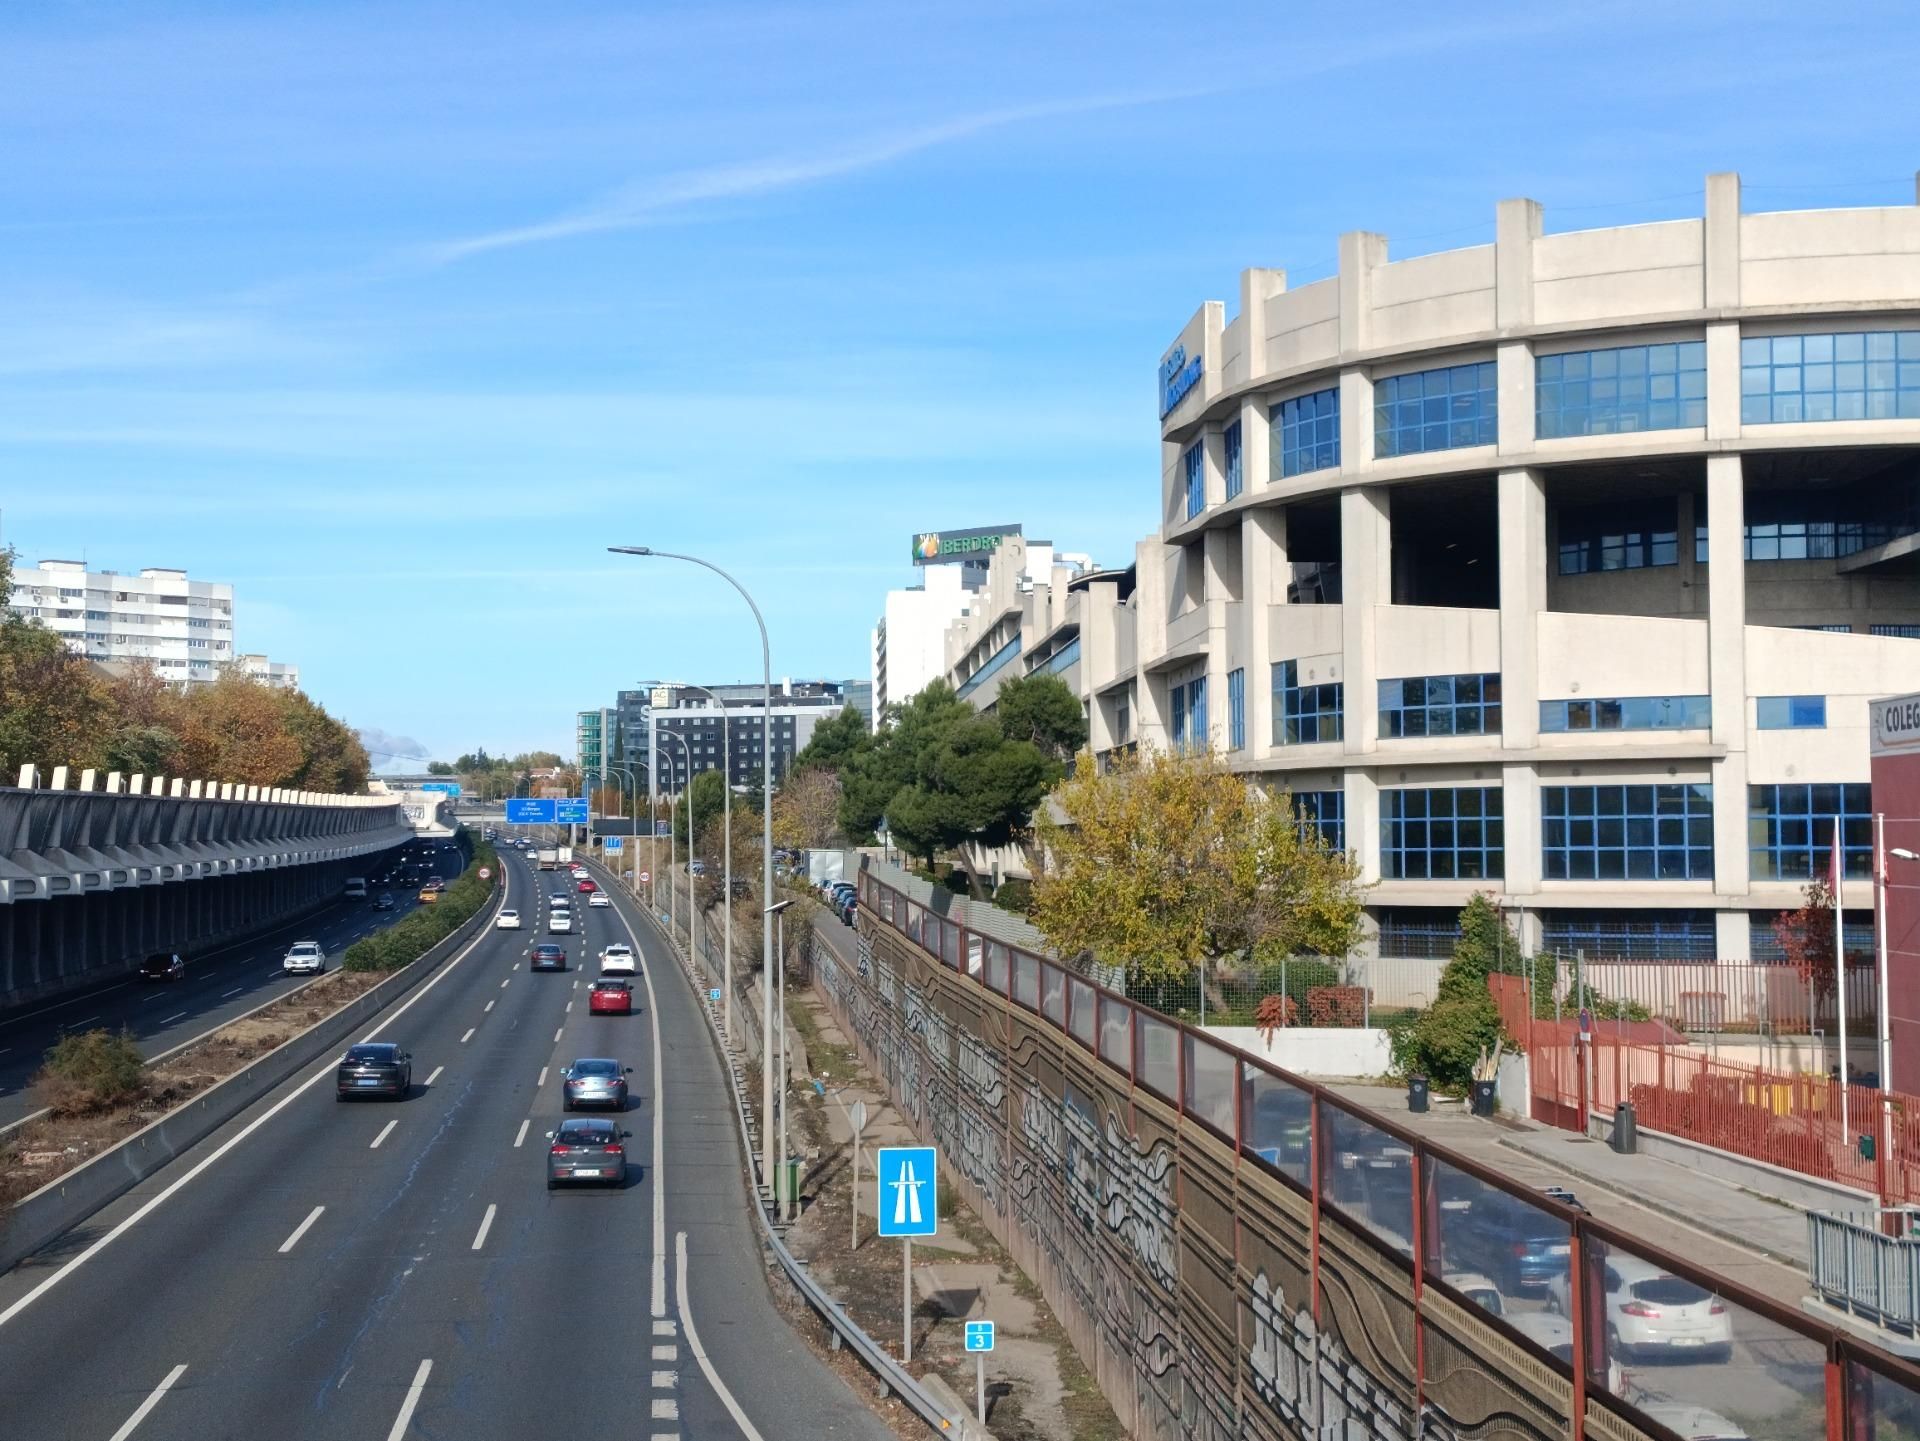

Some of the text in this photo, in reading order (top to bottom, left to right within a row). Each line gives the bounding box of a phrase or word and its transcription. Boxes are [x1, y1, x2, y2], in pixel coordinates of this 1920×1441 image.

[939, 535, 1005, 554] IBERDRO
[1886, 702, 1920, 732] COLEG
[975, 1335, 984, 1347] 3
